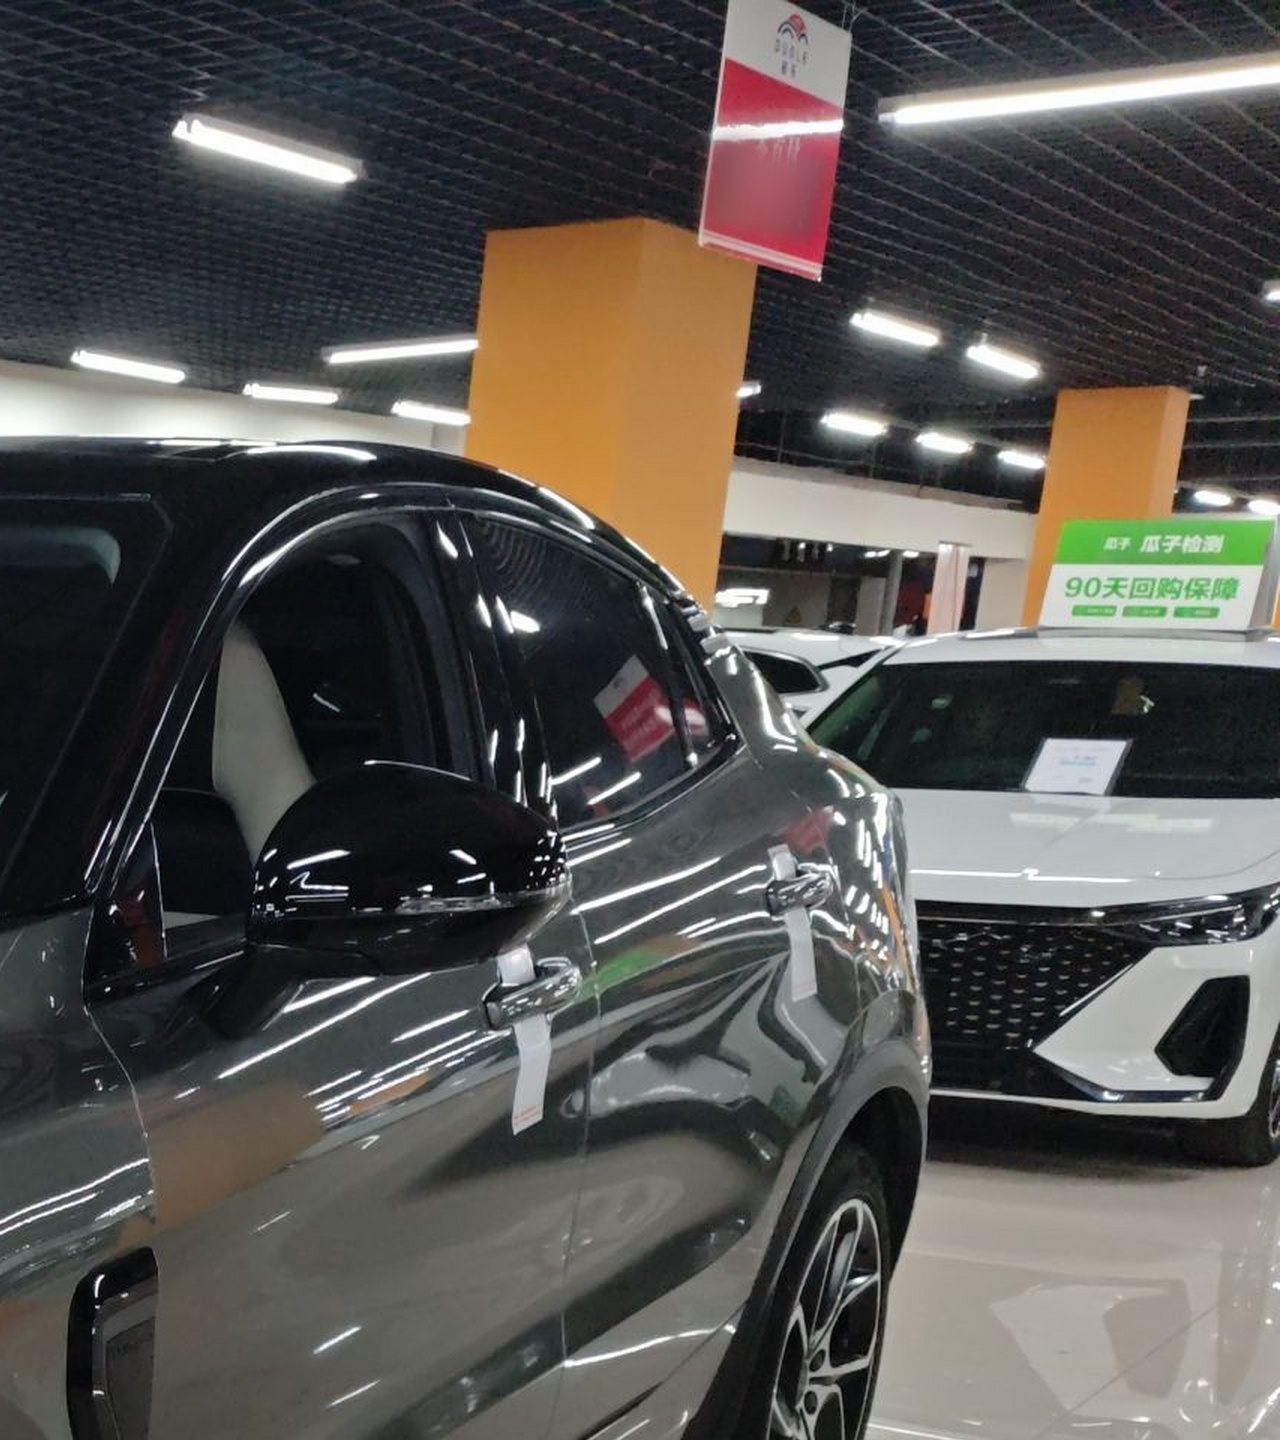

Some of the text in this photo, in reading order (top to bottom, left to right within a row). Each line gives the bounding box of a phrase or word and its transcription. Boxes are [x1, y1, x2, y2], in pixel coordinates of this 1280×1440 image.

[1140, 534, 1225, 553] 瓜子检测
[1065, 576, 1239, 600] 90天回购保障
